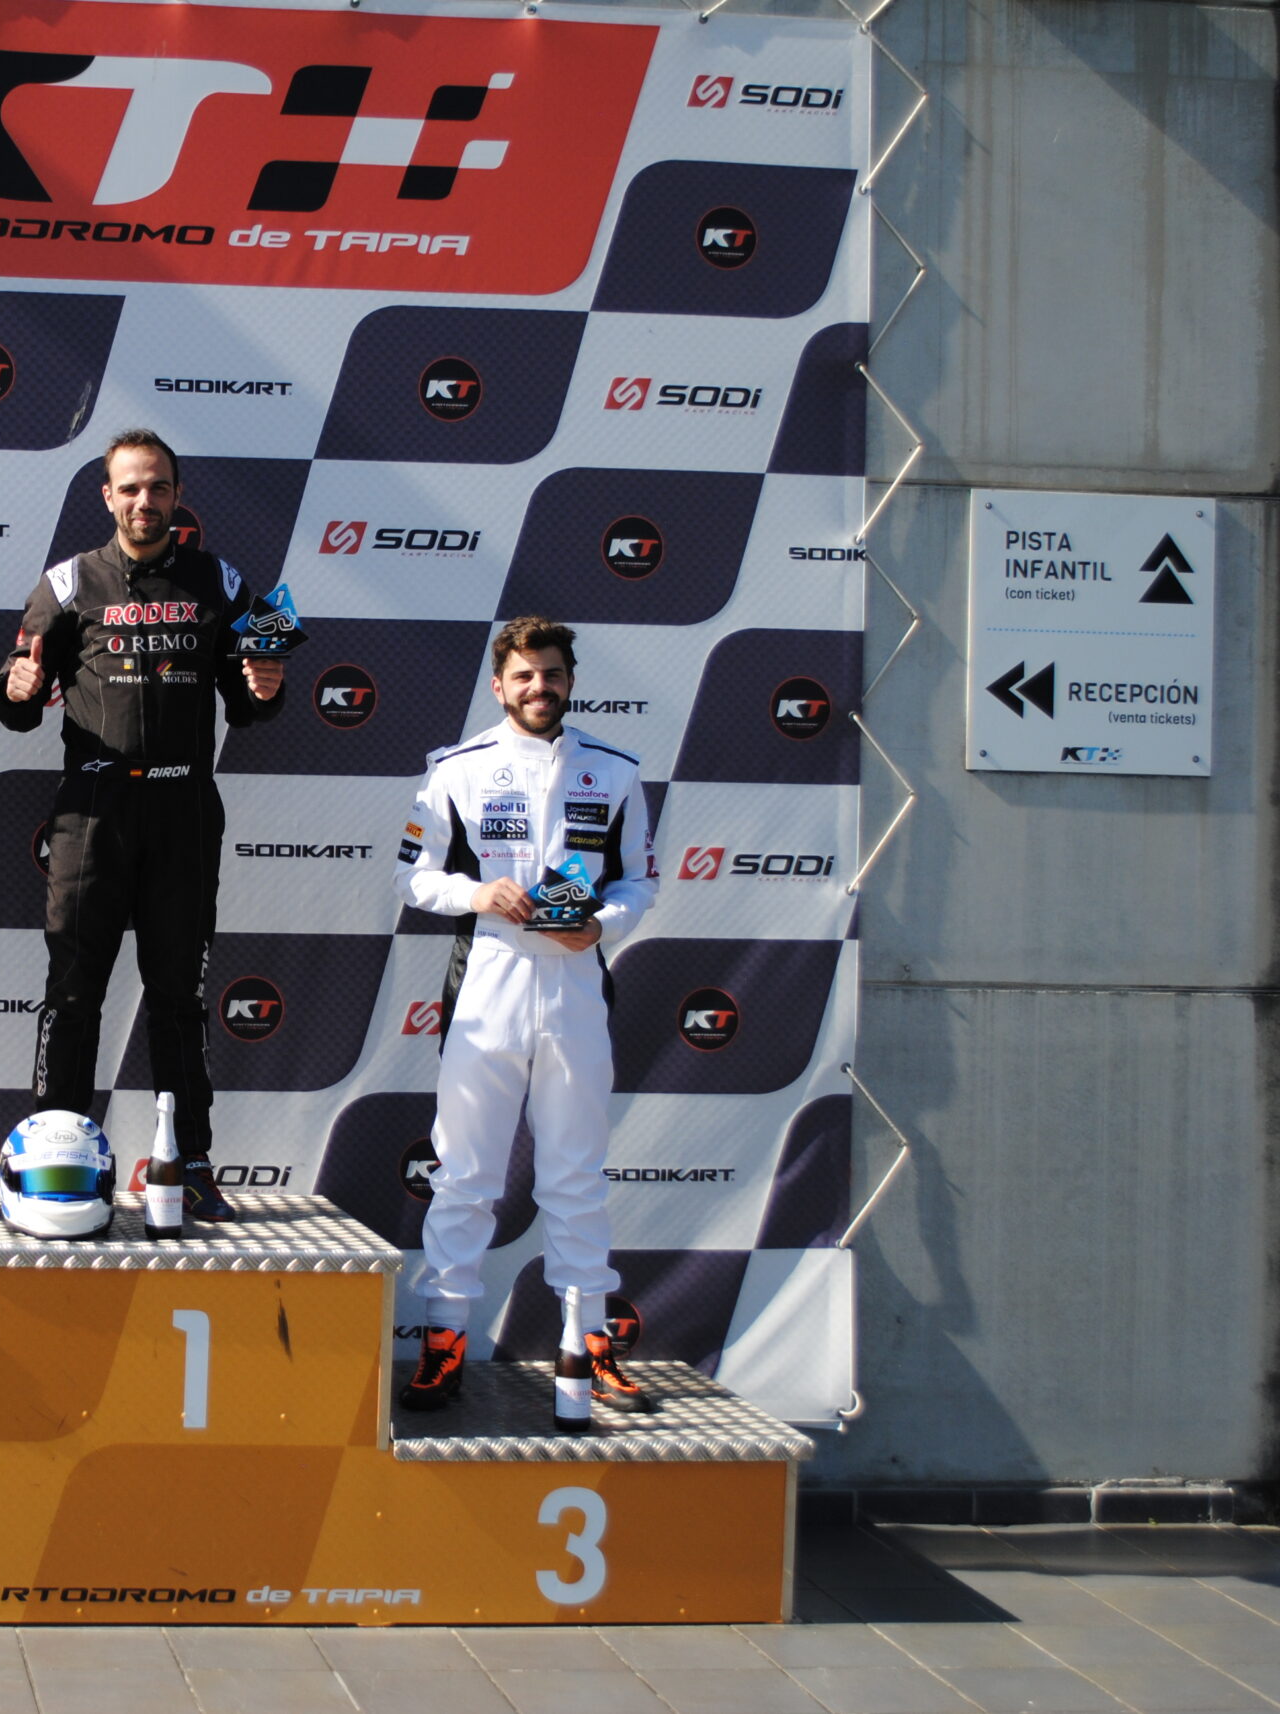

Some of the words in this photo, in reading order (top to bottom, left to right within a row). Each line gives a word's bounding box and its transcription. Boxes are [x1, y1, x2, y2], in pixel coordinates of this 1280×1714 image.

[228, 223, 290, 249] de
[303, 229, 470, 256] TAPIA
[702, 228, 752, 248] KT
[155, 378, 293, 396] SODIKART
[426, 379, 477, 399] KT
[608, 538, 659, 558] KT
[1005, 530, 1072, 552] PISTA
[1005, 559, 1112, 581] INFANTIL
[275, 591, 285, 606] 1
[1005, 587, 1032, 601] (con
[1036, 588, 1075, 602] ticket)
[103, 601, 199, 626] RODEX
[132, 634, 198, 653] REMO
[109, 675, 150, 685] PRISMA
[162, 675, 198, 684] MOLDES
[320, 687, 372, 707] KT
[1069, 679, 1199, 705] RECEPCIÓN
[776, 699, 827, 719] KT
[1108, 711, 1147, 725] (venta
[1150, 712, 1196, 726] tickets)
[147, 765, 191, 779] AIRON
[567, 789, 610, 799] vodafone
[482, 802, 514, 812] Mobil
[482, 820, 526, 833] BOSS
[235, 843, 373, 859] SODIKART
[566, 863, 581, 875] 3
[226, 999, 279, 1019] KT
[683, 1009, 737, 1029] KT
[214, 1165, 293, 1187] ODi
[601, 1168, 736, 1182] SODIKART
[172, 1309, 210, 1429] 1
[535, 1486, 607, 1604] 3
[246, 1585, 292, 1604] de
[301, 1588, 421, 1605] TAPIA
